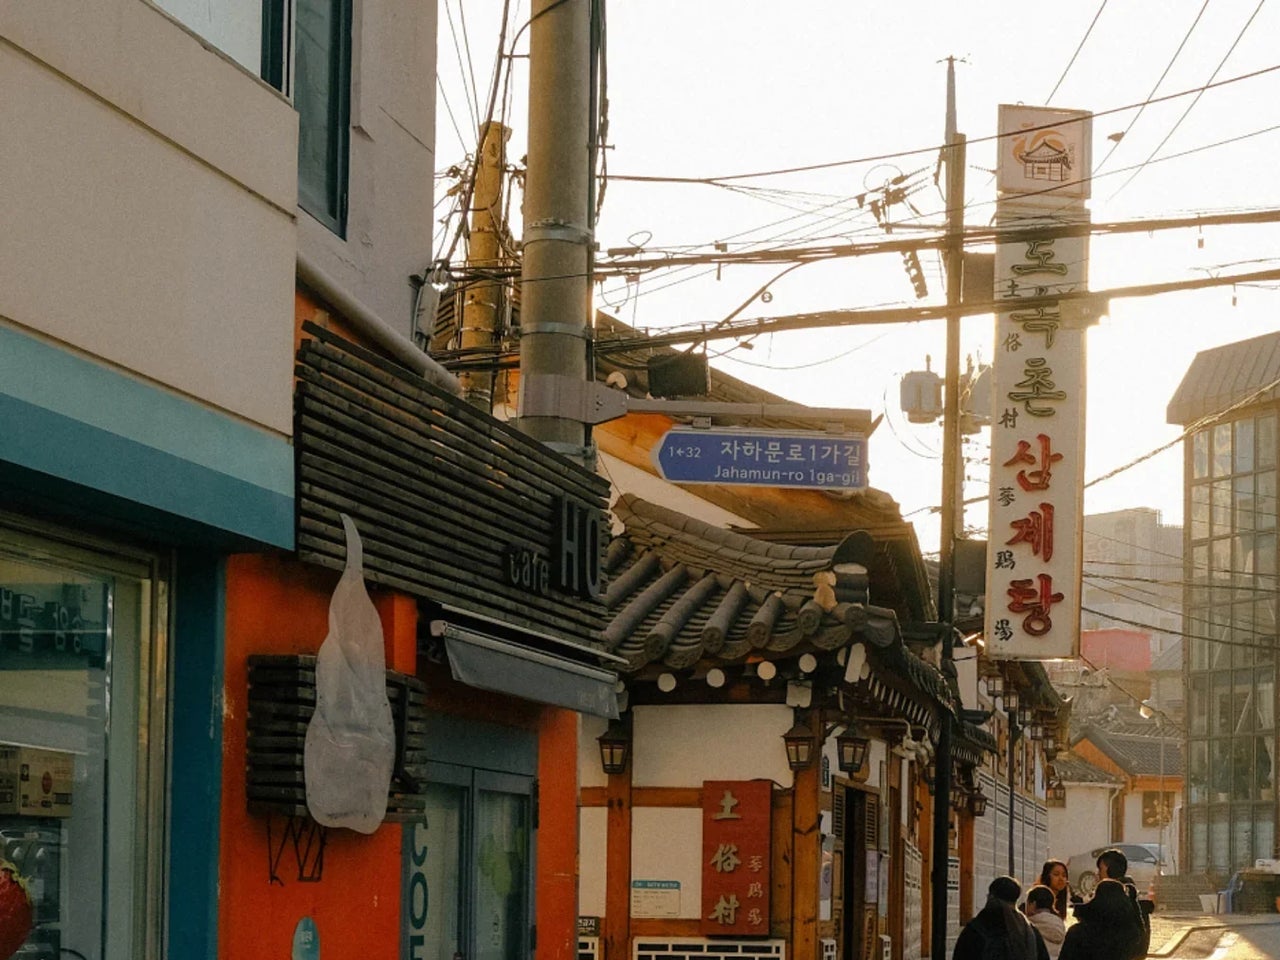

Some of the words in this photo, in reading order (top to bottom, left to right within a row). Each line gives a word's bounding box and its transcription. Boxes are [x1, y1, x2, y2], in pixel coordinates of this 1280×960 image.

[714, 465, 804, 482] Jahamun-ro
[809, 468, 860, 486] 1ga-gil
[720, 439, 861, 467] 자하문로1가길
[1002, 433, 1065, 637] 삼계탕
[708, 790, 742, 926] 土俗村
